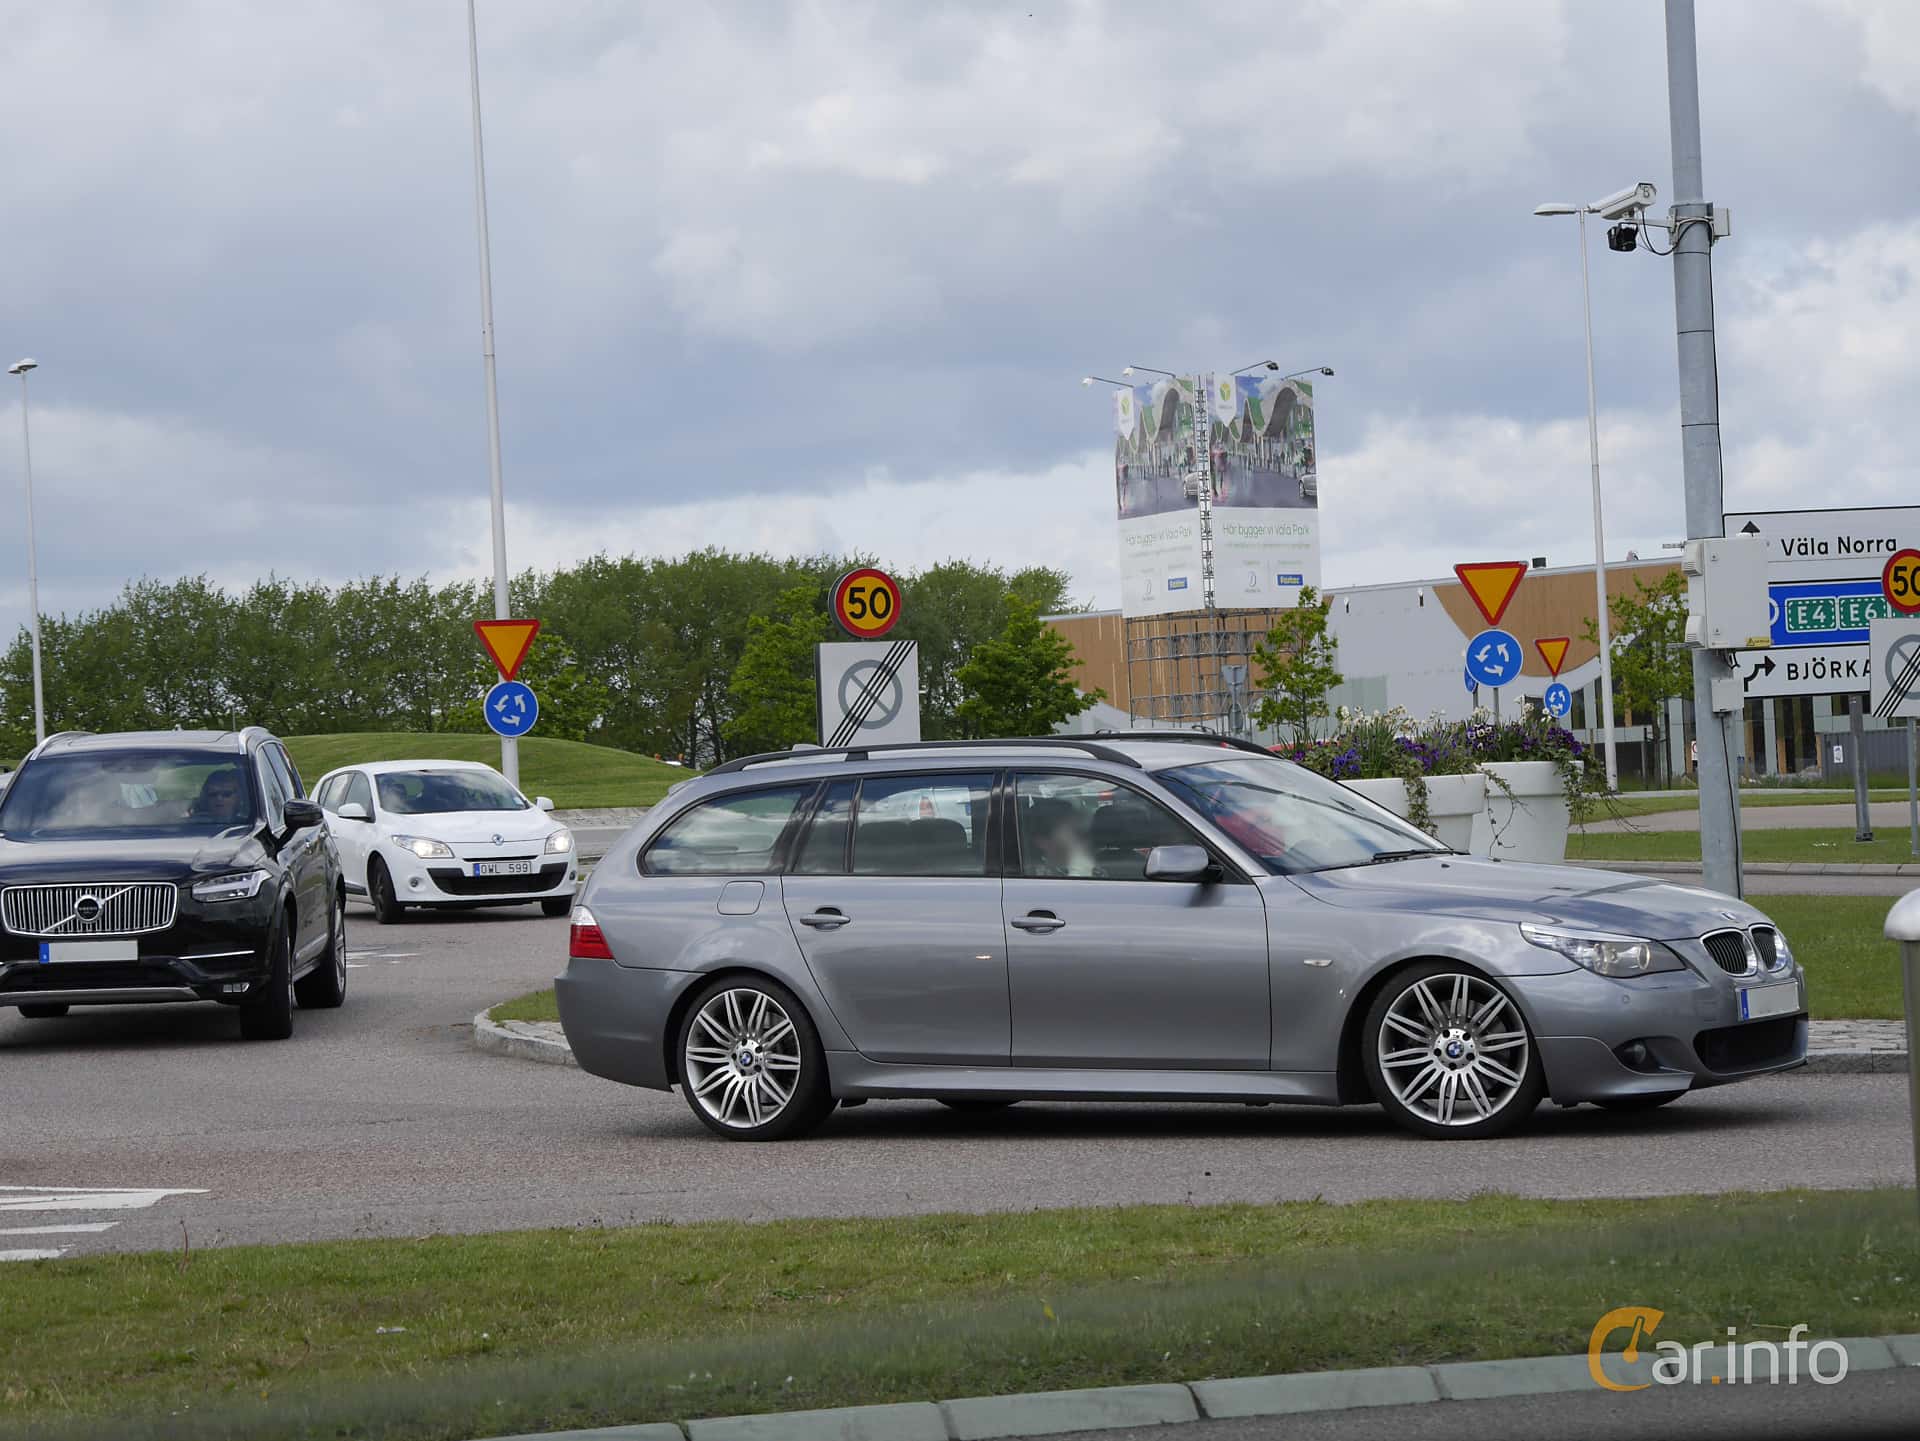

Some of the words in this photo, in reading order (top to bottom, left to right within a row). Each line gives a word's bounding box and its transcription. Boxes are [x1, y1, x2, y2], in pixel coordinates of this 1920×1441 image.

[1781, 538, 1829, 556] Väla
[1838, 536, 1897, 554] Norra
[848, 587, 892, 620] 50
[508, 863, 528, 873] 599
